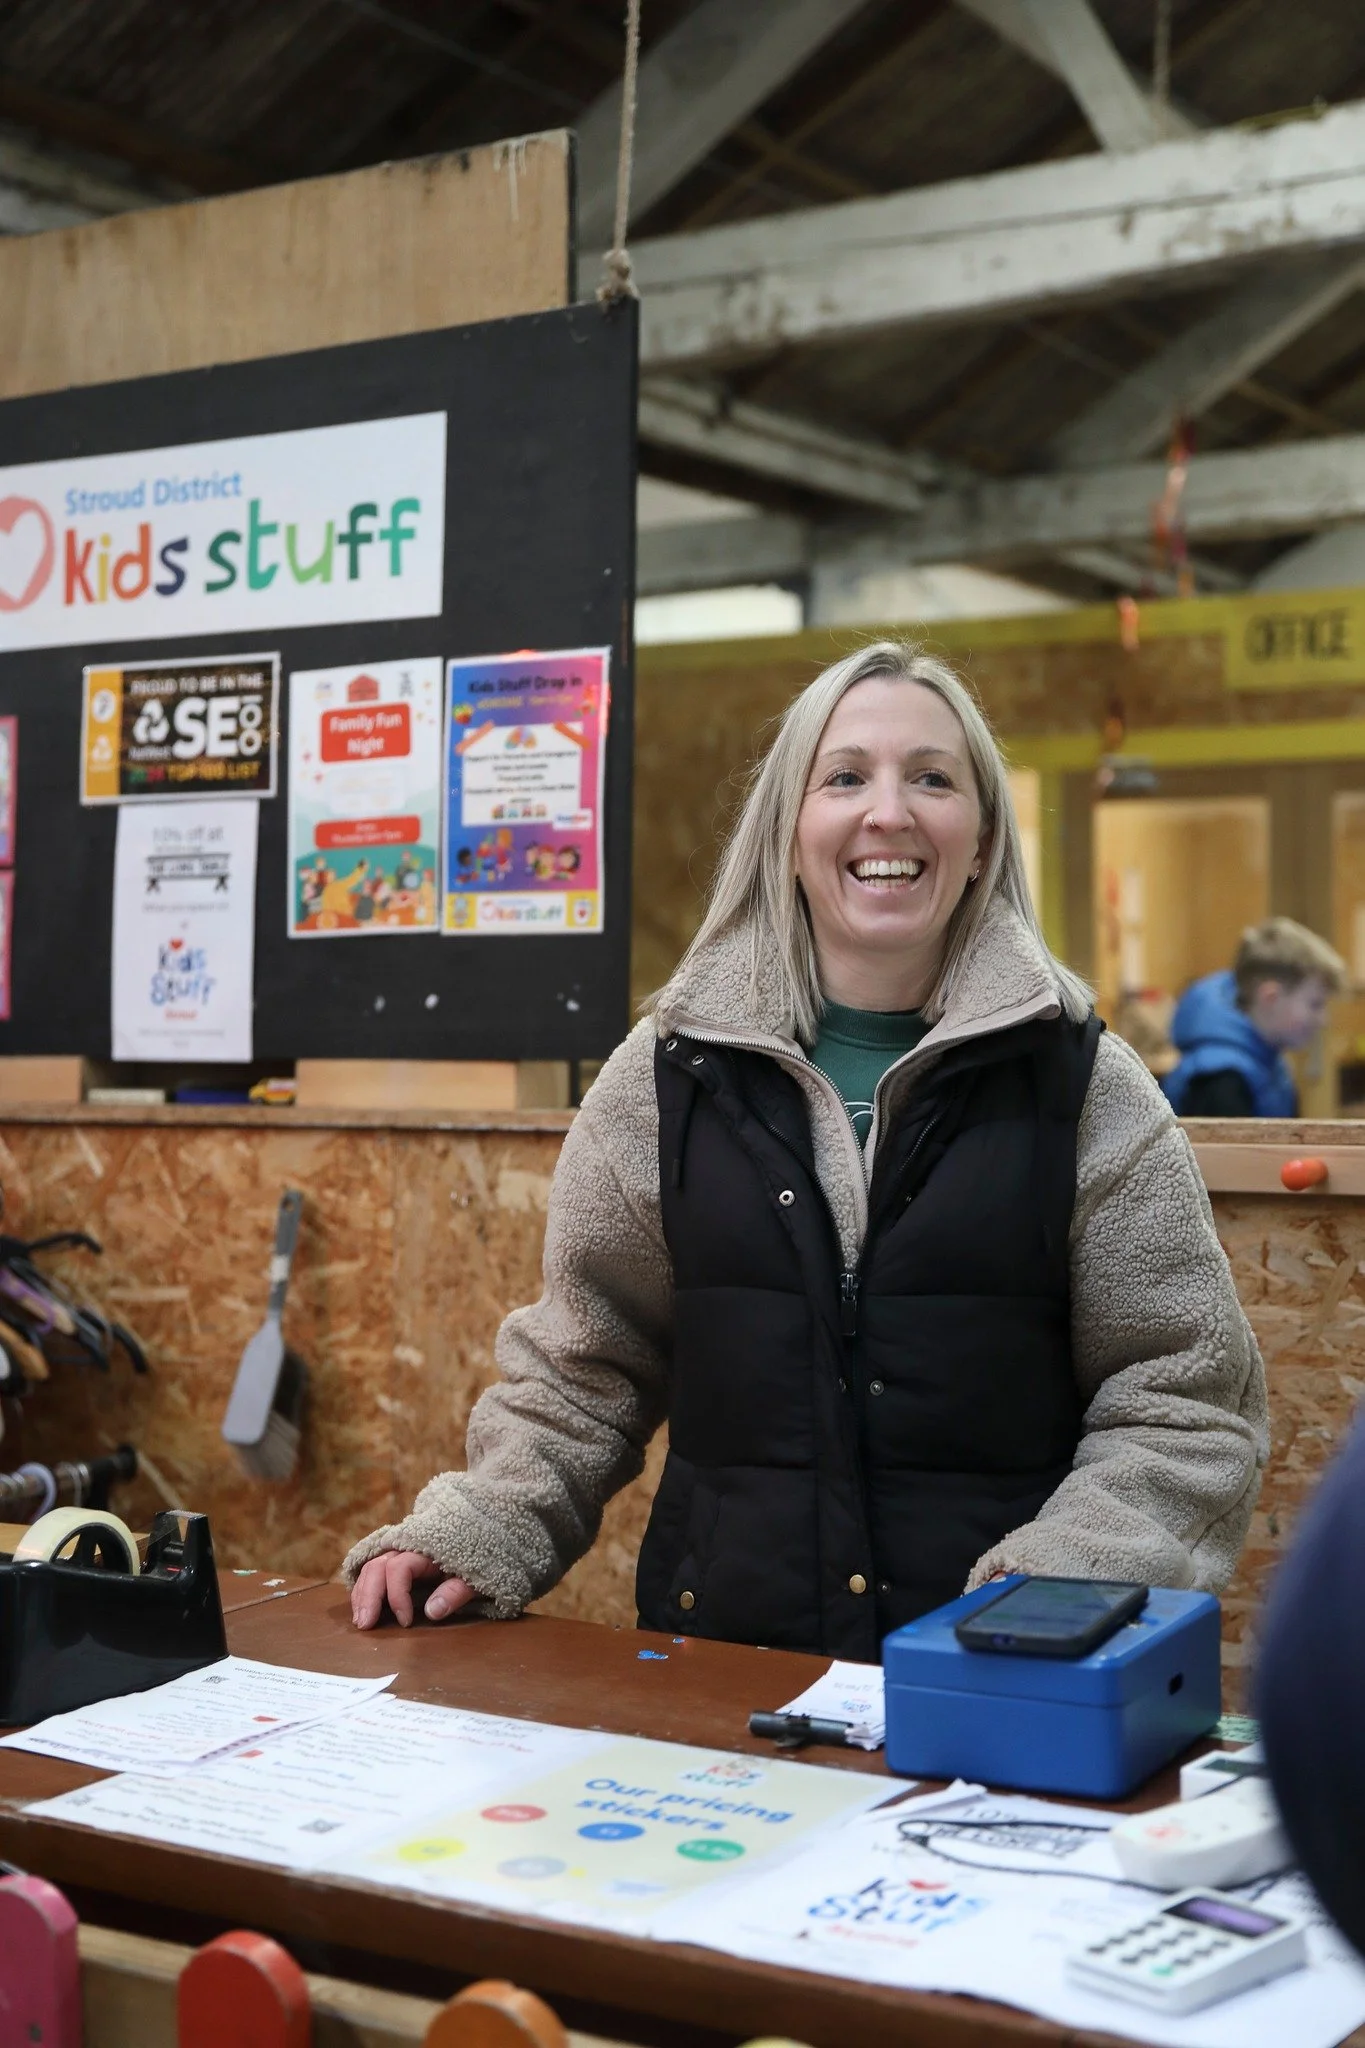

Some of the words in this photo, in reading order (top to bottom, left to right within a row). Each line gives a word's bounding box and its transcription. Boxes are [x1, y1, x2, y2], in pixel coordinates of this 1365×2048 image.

[65, 481, 144, 516] Stroud
[154, 472, 242, 506] District
[64, 523, 188, 606] kids
[205, 498, 420, 593] stuff
[534, 675, 565, 690] Drop
[330, 714, 375, 734] Family
[376, 712, 403, 729] Fun
[347, 736, 385, 756] Night
[575, 1799, 728, 1832] stickers
[585, 1778, 656, 1798] Our
[657, 1791, 795, 1823] pricing
